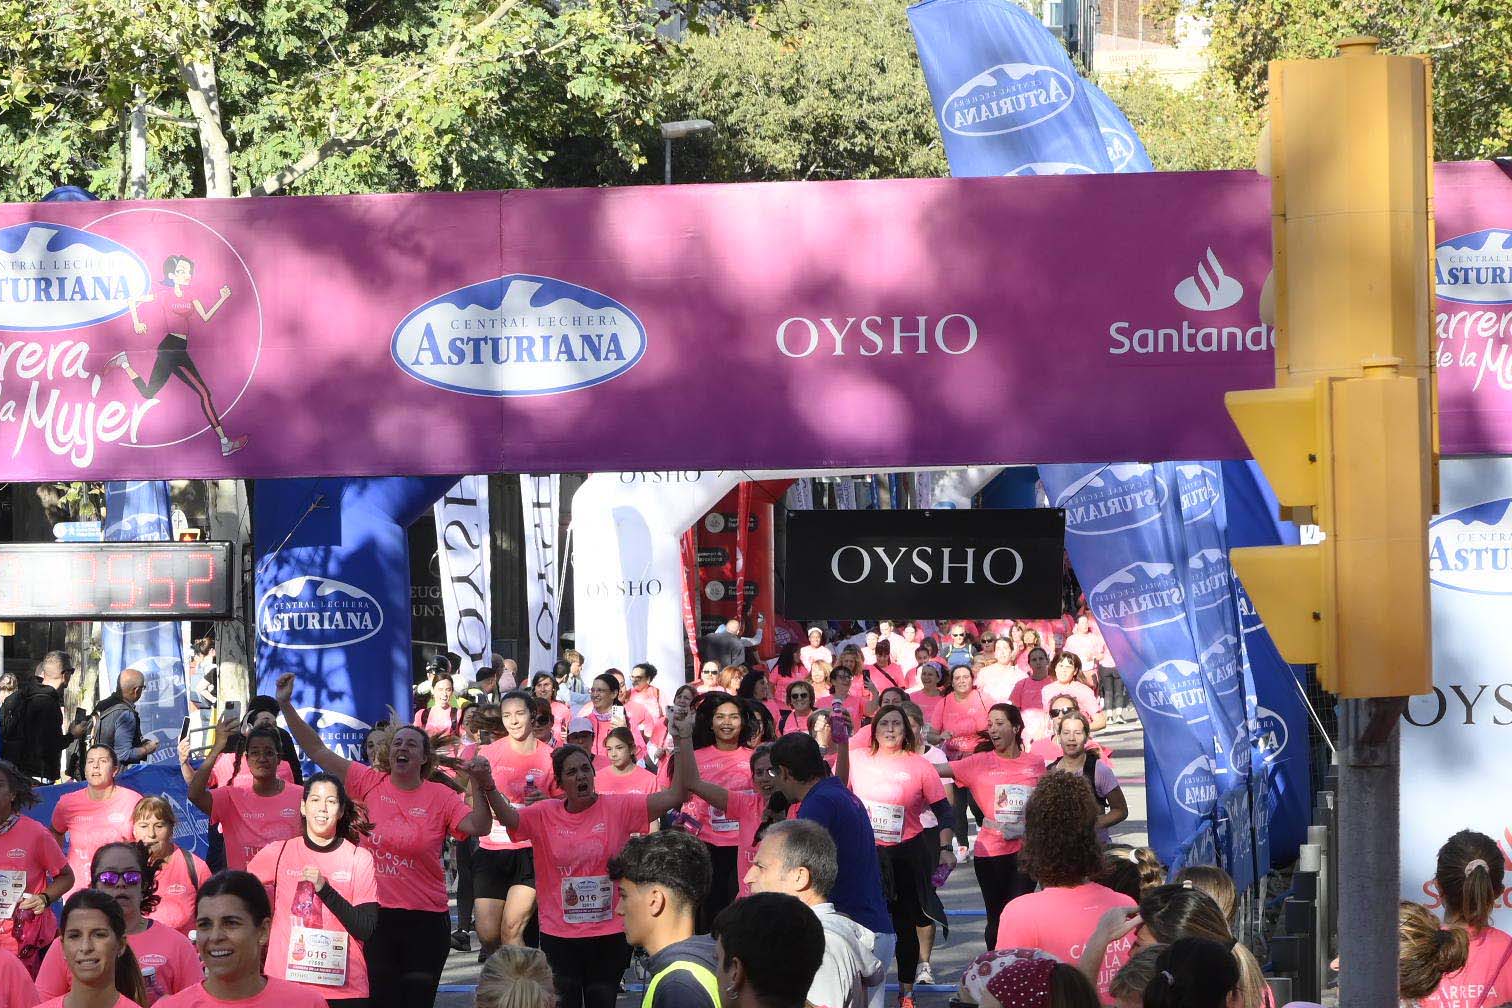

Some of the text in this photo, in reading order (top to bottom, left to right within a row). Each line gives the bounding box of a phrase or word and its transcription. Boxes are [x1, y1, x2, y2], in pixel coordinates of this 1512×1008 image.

[1449, 254, 1500, 264] CENTRAL
[450, 314, 619, 330] CENTRAL LECHERA
[1436, 310, 1512, 339] arrer
[411, 322, 627, 367] ASTURIANA
[775, 311, 978, 358] OYSHO
[1109, 321, 1276, 356] Santand
[1459, 340, 1478, 368] la
[12, 375, 160, 468] Mujer
[831, 545, 1024, 586] OYSHO
[587, 578, 663, 598] OYSHO
[274, 600, 370, 610] CENTRAL LECHERA
[261, 608, 375, 632] ASTURIANA
[1402, 684, 1512, 727] OYS
[321, 731, 365, 740] LECHER
[557, 865, 572, 877] TU
[579, 894, 597, 902] 016
[307, 950, 327, 959] 016
